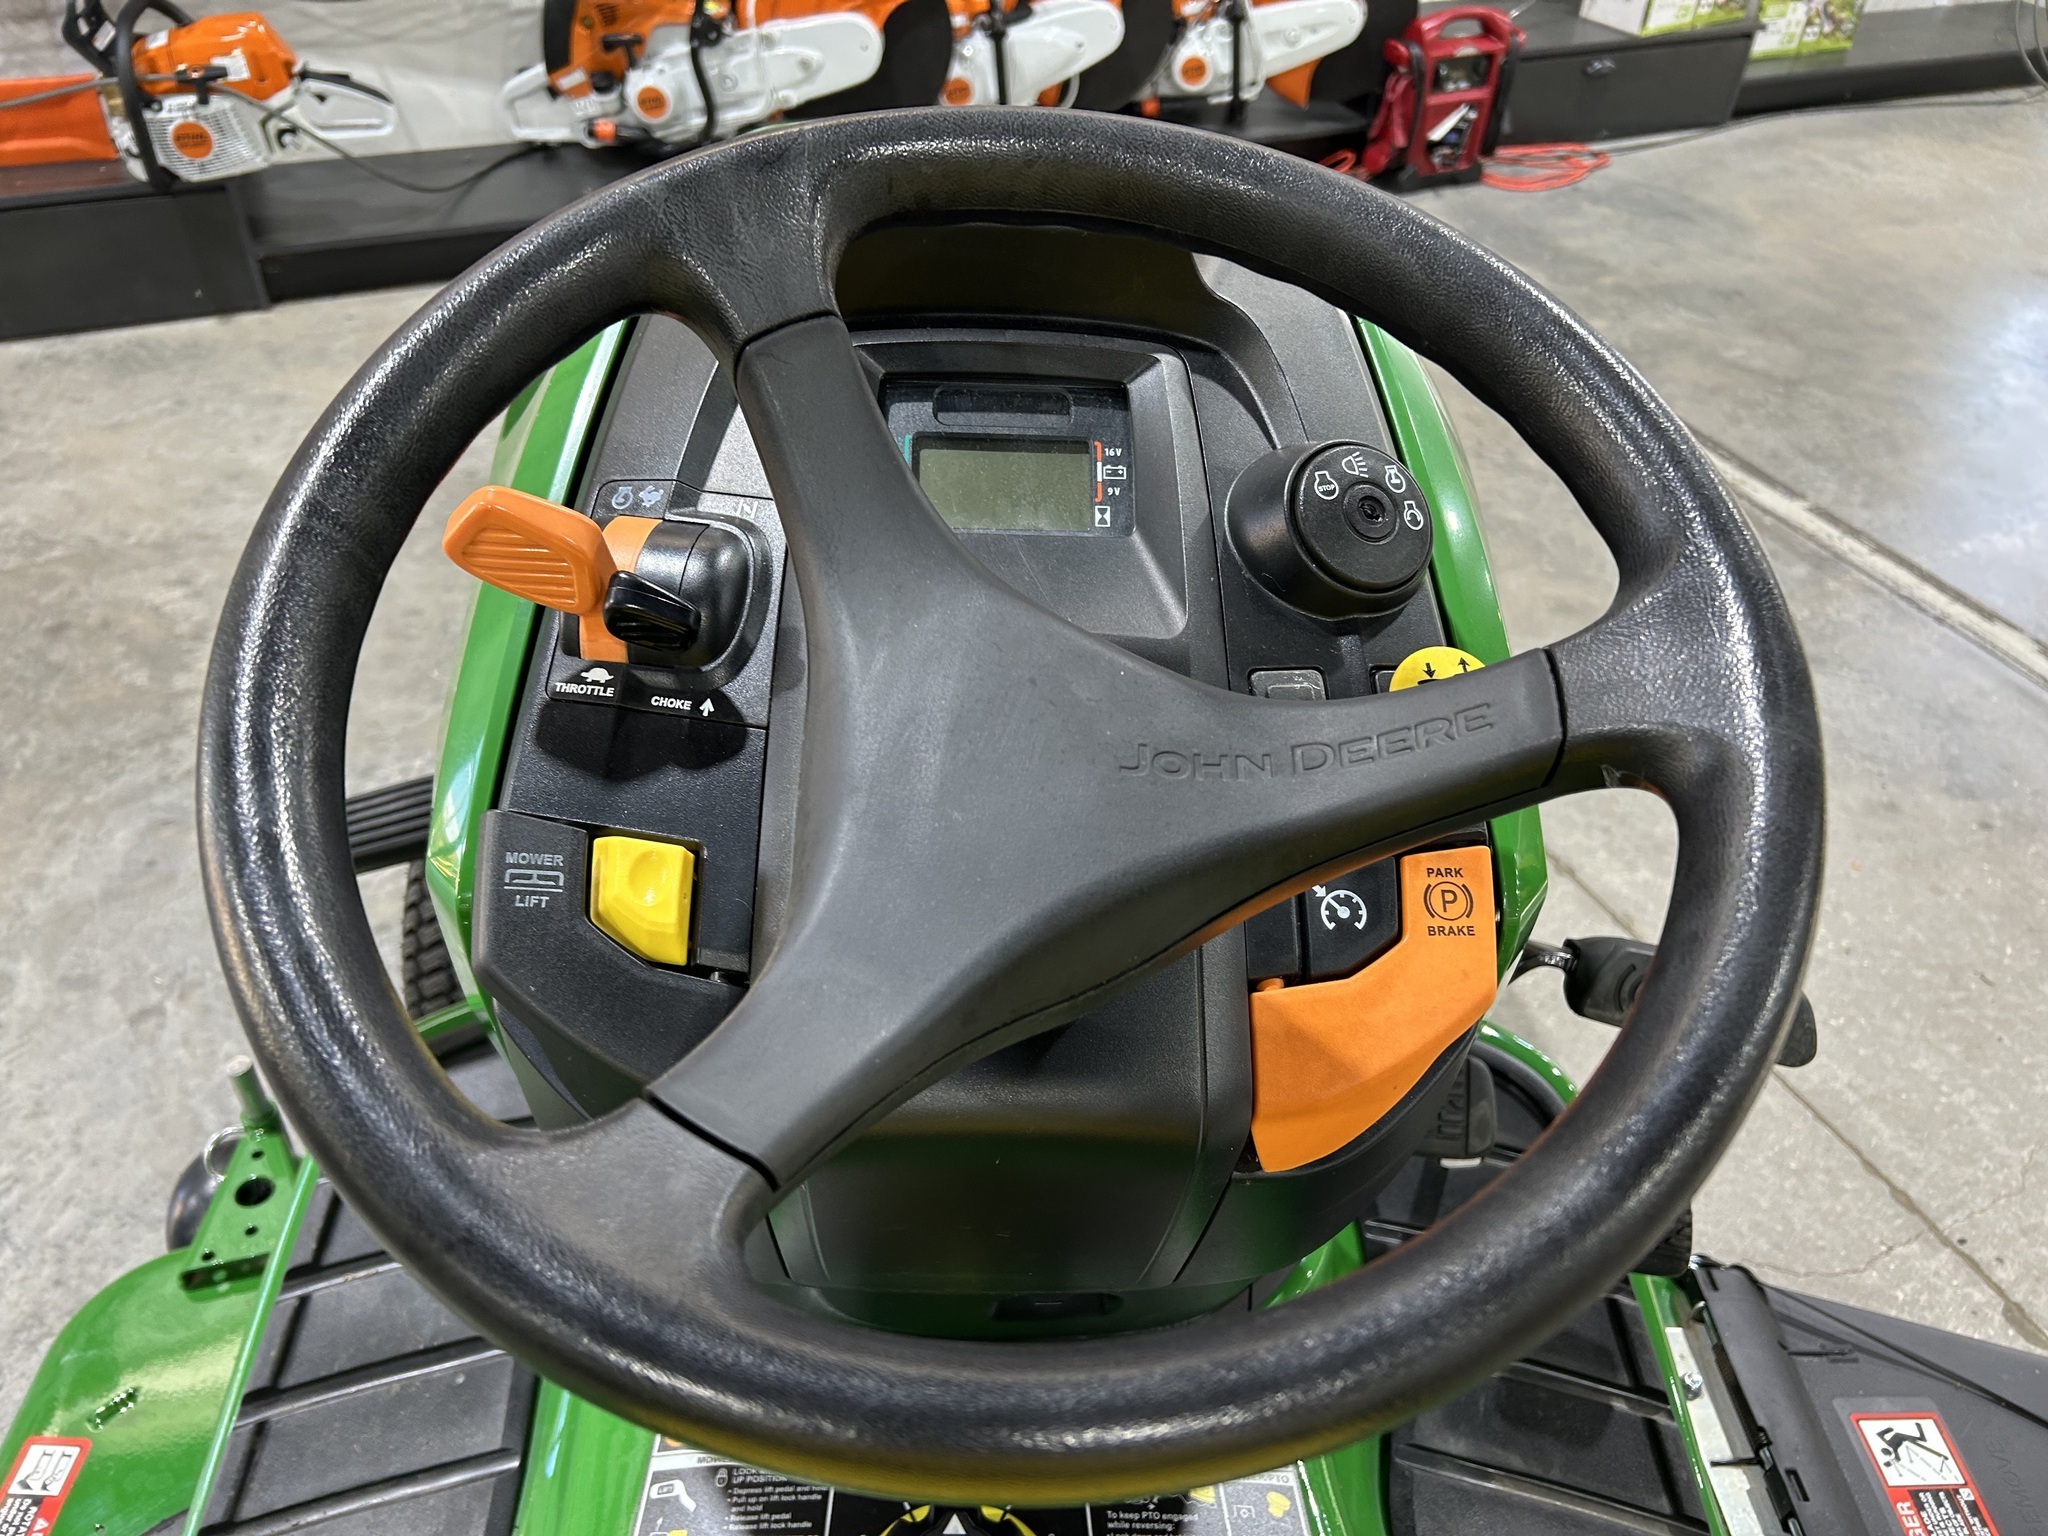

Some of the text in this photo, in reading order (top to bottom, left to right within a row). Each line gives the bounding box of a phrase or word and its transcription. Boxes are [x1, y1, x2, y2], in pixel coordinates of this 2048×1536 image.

[1317, 484, 1336, 492] STOP
[555, 682, 615, 697] THROTTLE
[651, 696, 692, 710] CHOKE
[1119, 703, 1496, 782] JOHN DEERE
[505, 851, 564, 867] MOWER
[1426, 867, 1464, 878] PARK
[515, 894, 549, 908] LIFT
[1427, 925, 1476, 937] BRAKE
[1106, 1510, 1118, 1519] To
